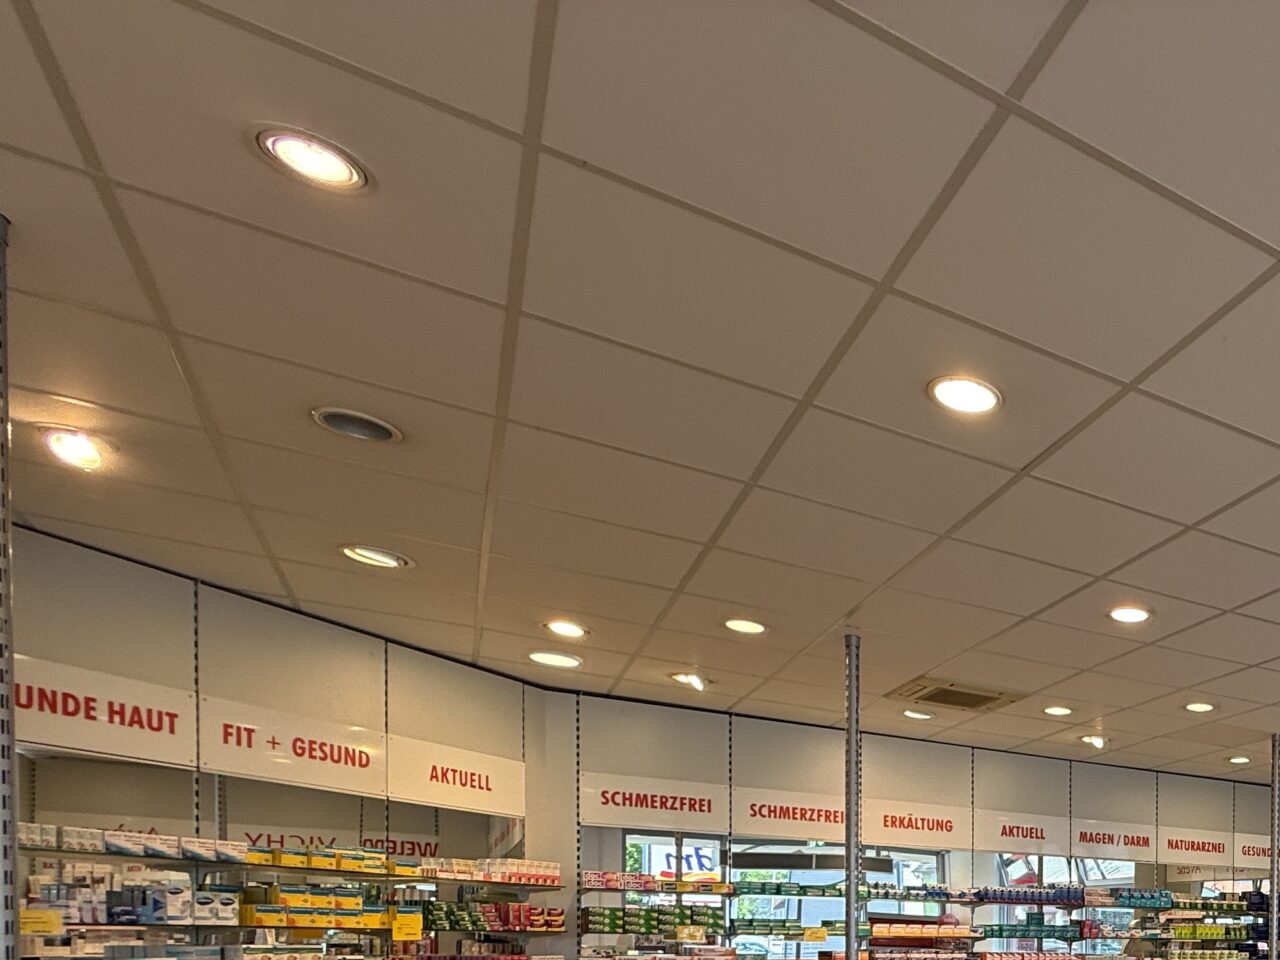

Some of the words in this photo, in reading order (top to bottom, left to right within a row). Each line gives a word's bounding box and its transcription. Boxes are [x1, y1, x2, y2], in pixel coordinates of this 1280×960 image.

[14, 683, 97, 721] UNDE
[107, 701, 179, 735] HAUT
[222, 723, 256, 749] FIT
[266, 735, 282, 751] +
[292, 737, 371, 769] GESUND
[429, 765, 493, 792] AKTUELL
[600, 790, 712, 814] SCHMERZFREI
[749, 803, 844, 825] SCHMERZFREI
[882, 812, 954, 833] ERKÄLTUNG
[1000, 825, 1046, 840] AKTUELL
[1079, 831, 1115, 845] MAGEN
[1123, 834, 1150, 847] DARM
[1167, 838, 1225, 854] NATURARZNEI
[1241, 845, 1271, 858] GESUND
